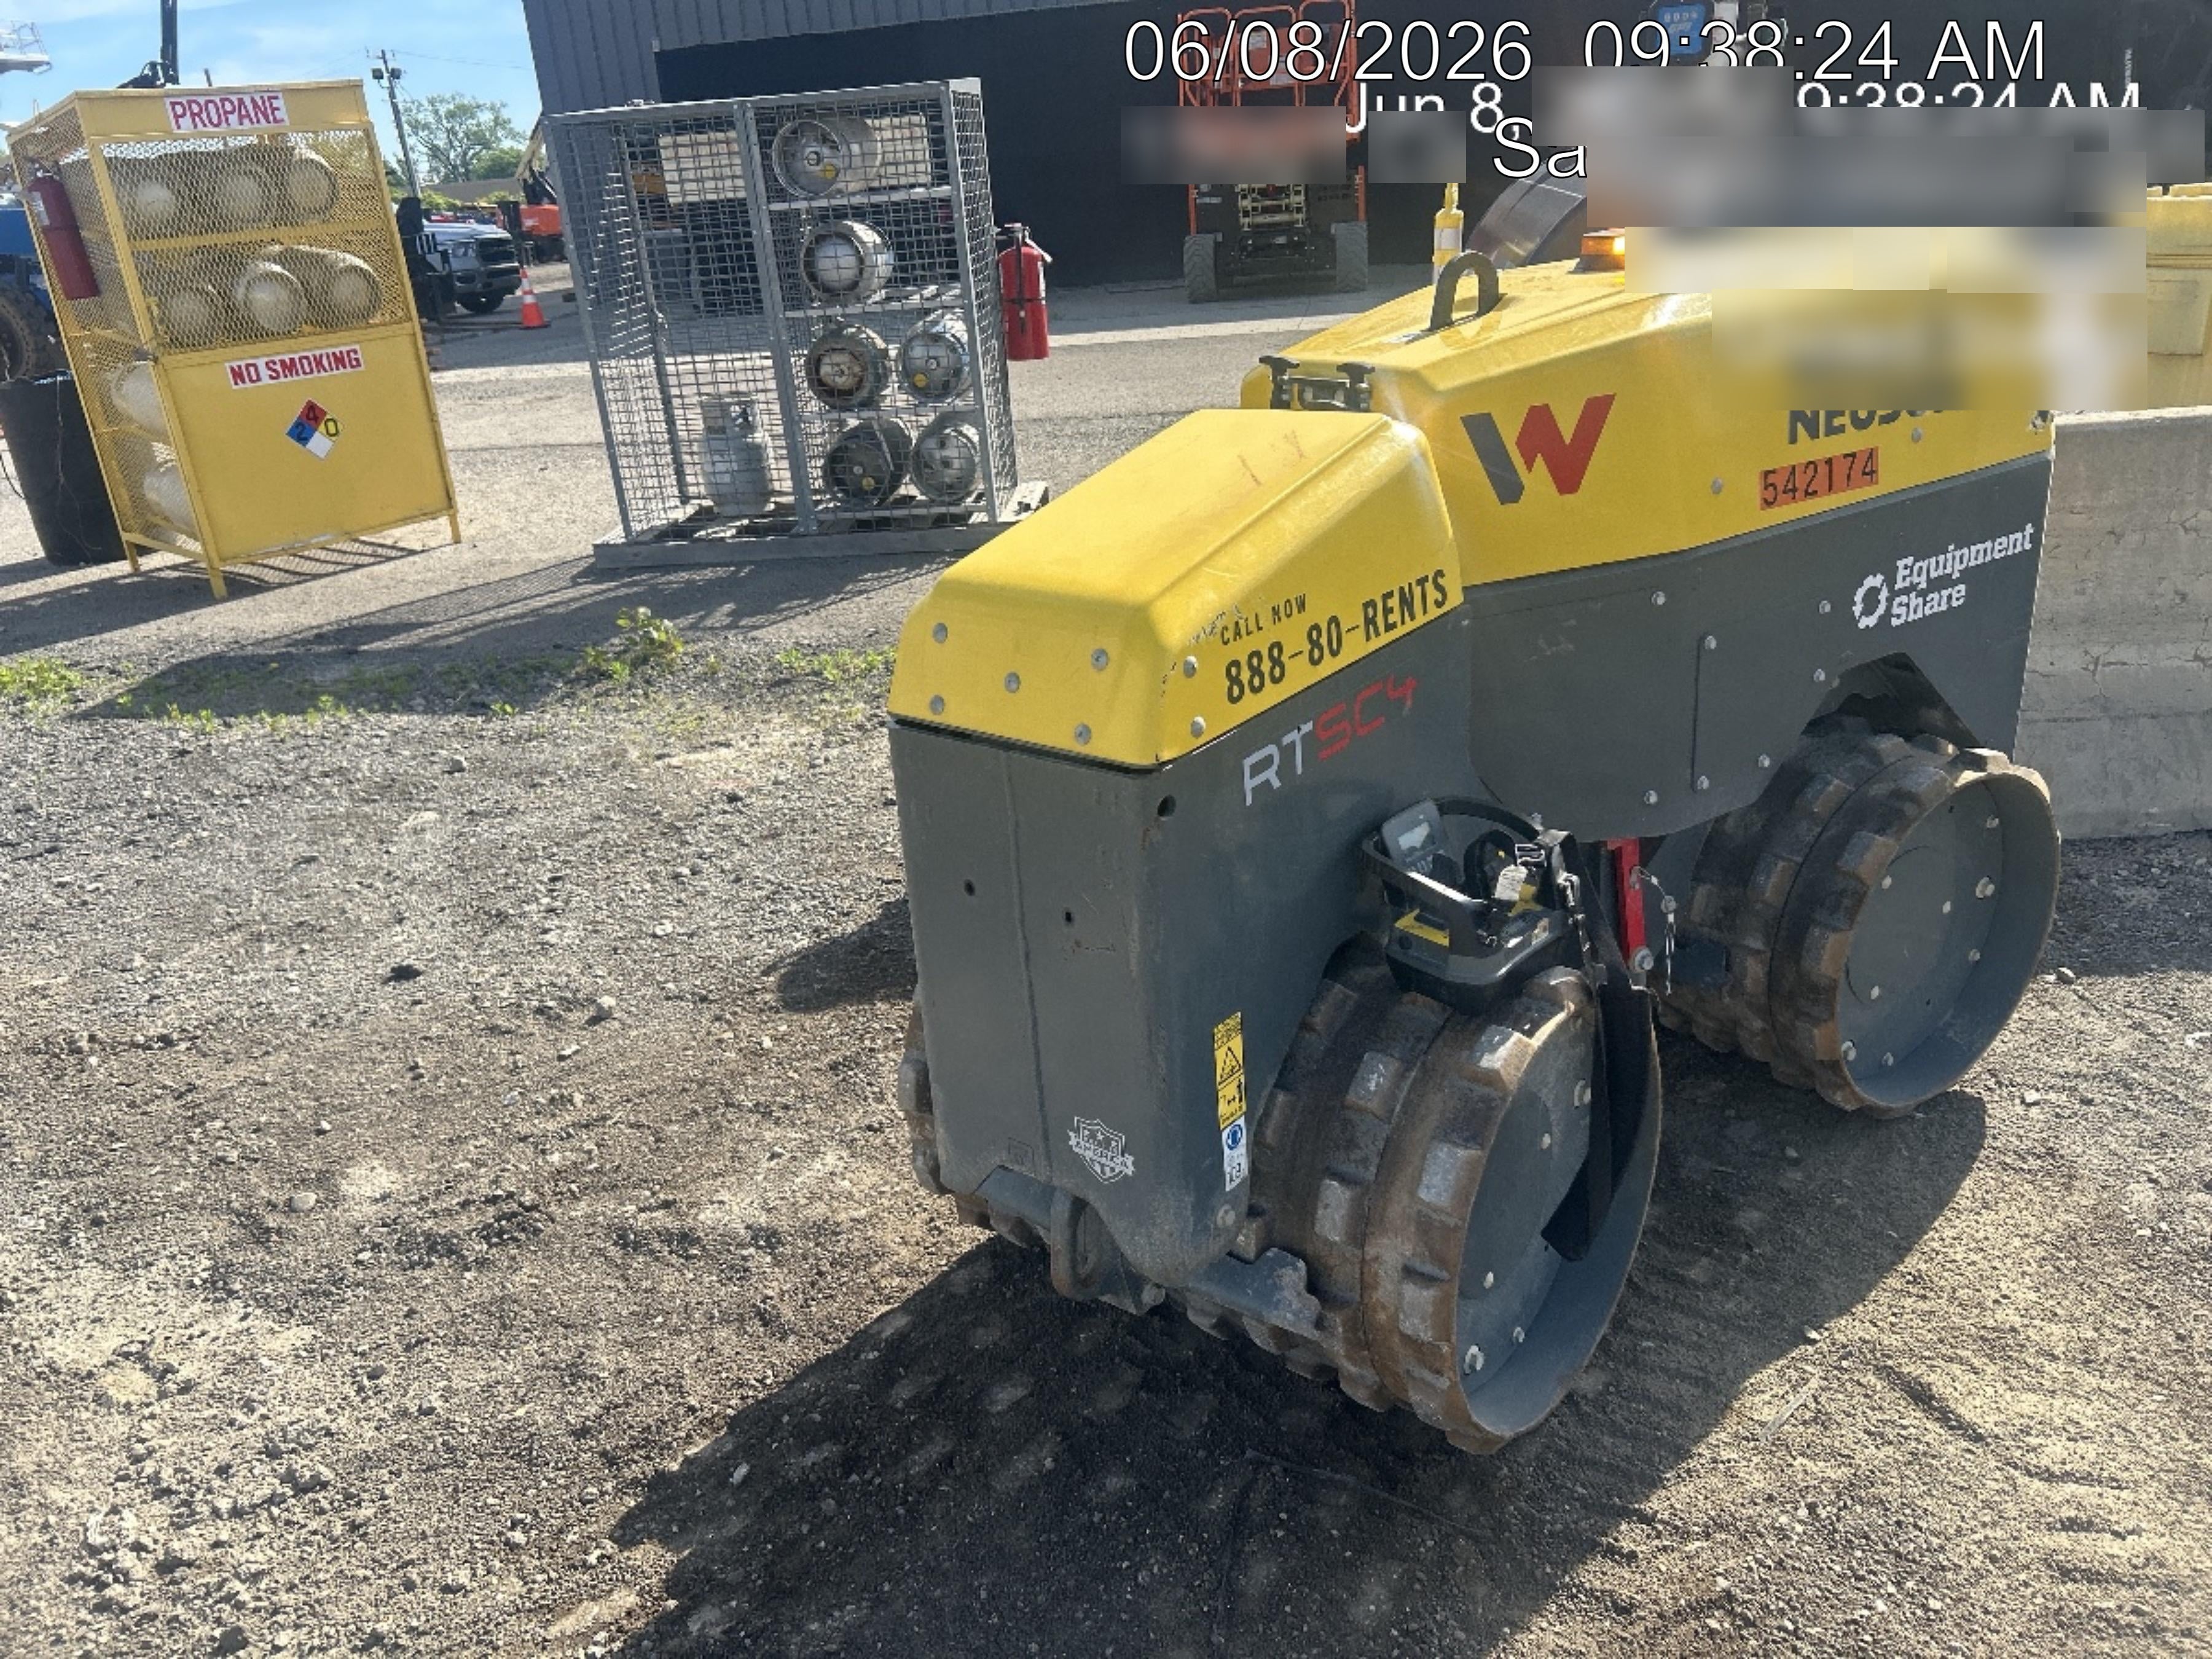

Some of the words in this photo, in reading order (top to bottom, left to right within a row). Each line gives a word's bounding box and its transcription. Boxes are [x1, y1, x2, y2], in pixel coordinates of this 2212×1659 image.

[170, 95, 284, 130] PROPANE
[229, 363, 262, 386] NO
[265, 348, 362, 380] SMOKING
[294, 422, 308, 441] 2
[305, 405, 320, 424] 4
[1762, 447, 1877, 506] 542174
[1894, 523, 2034, 590] Equipment
[1220, 613, 1264, 646] CALL
[1271, 593, 1306, 625] NOW
[1890, 584, 1966, 627] Share
[1225, 569, 1448, 705] 888-80-RENTS
